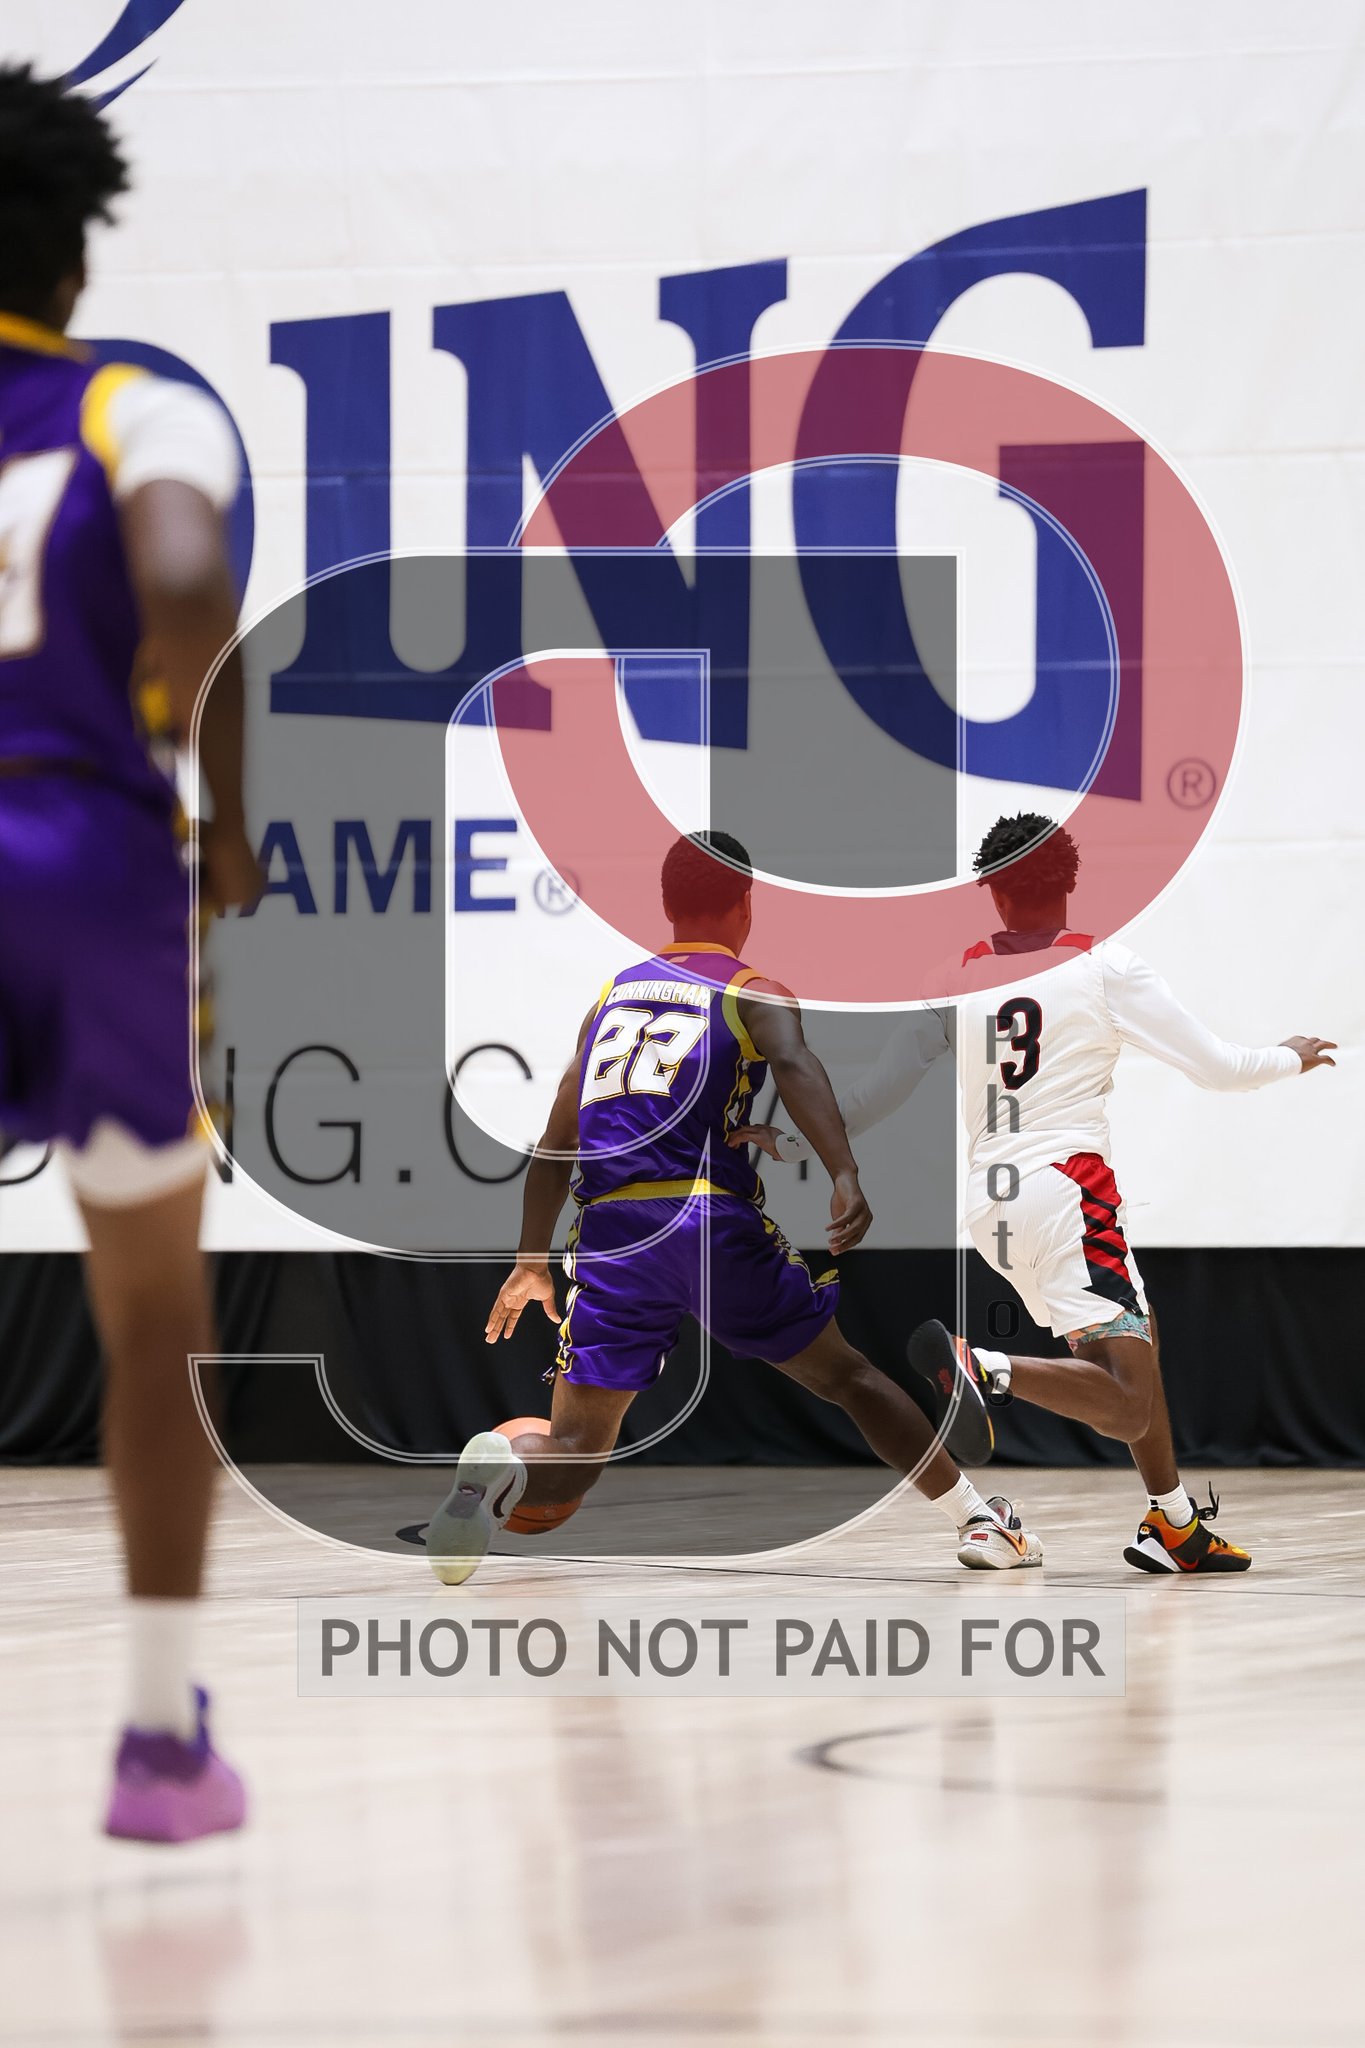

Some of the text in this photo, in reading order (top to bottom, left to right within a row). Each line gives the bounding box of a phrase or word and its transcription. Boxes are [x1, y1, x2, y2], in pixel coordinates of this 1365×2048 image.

[216, 817, 518, 919] AME
[605, 980, 711, 1010] CUNNINGHAM
[996, 997, 1043, 1091] 3
[579, 1006, 709, 1111] 22
